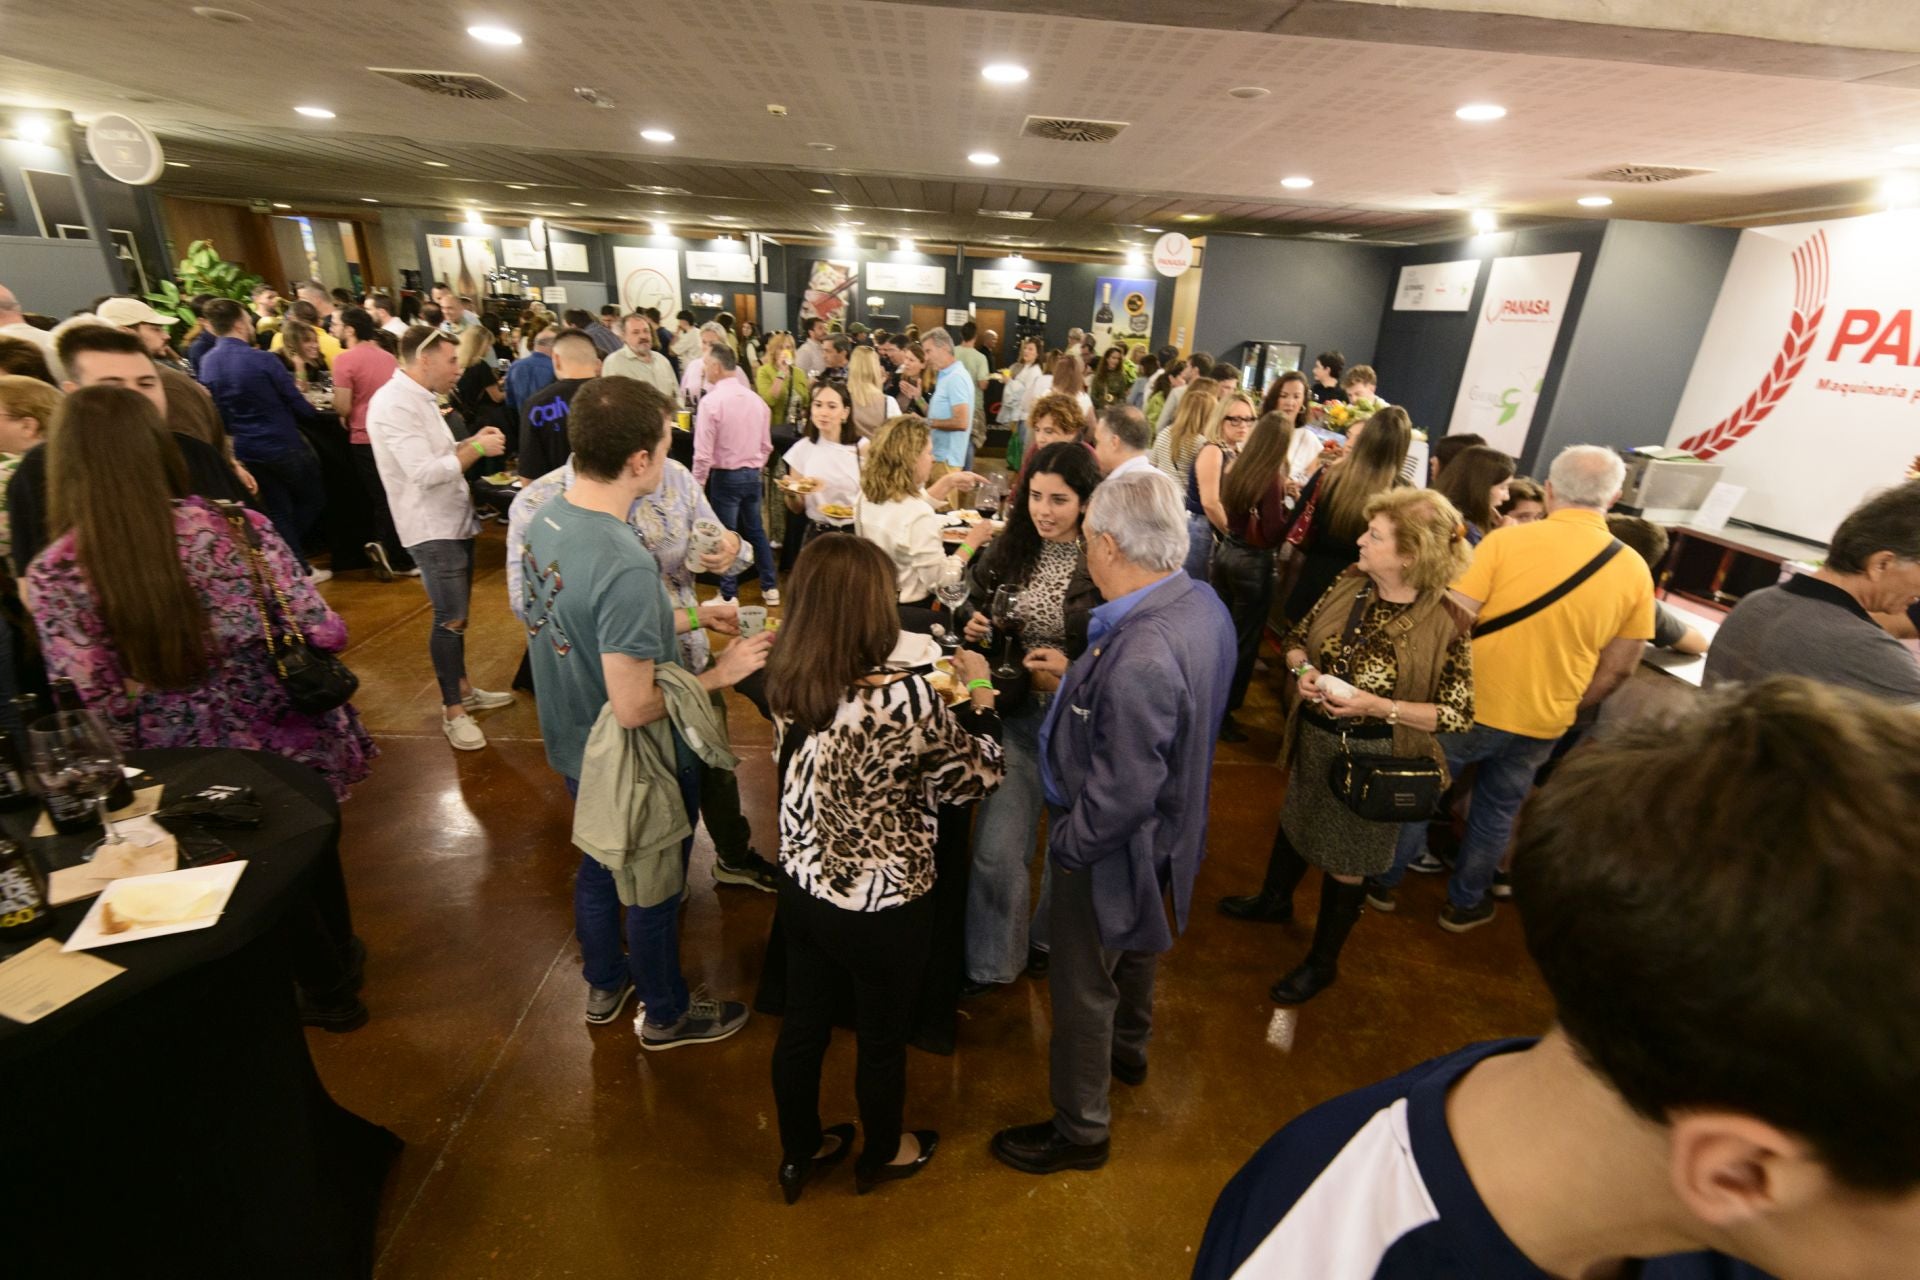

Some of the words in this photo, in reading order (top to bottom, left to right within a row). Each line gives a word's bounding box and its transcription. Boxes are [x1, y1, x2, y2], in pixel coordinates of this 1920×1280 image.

[1502, 299, 1551, 316] PANASA
[1826, 309, 1920, 367] PA
[1816, 377, 1907, 398] Maquinaria
